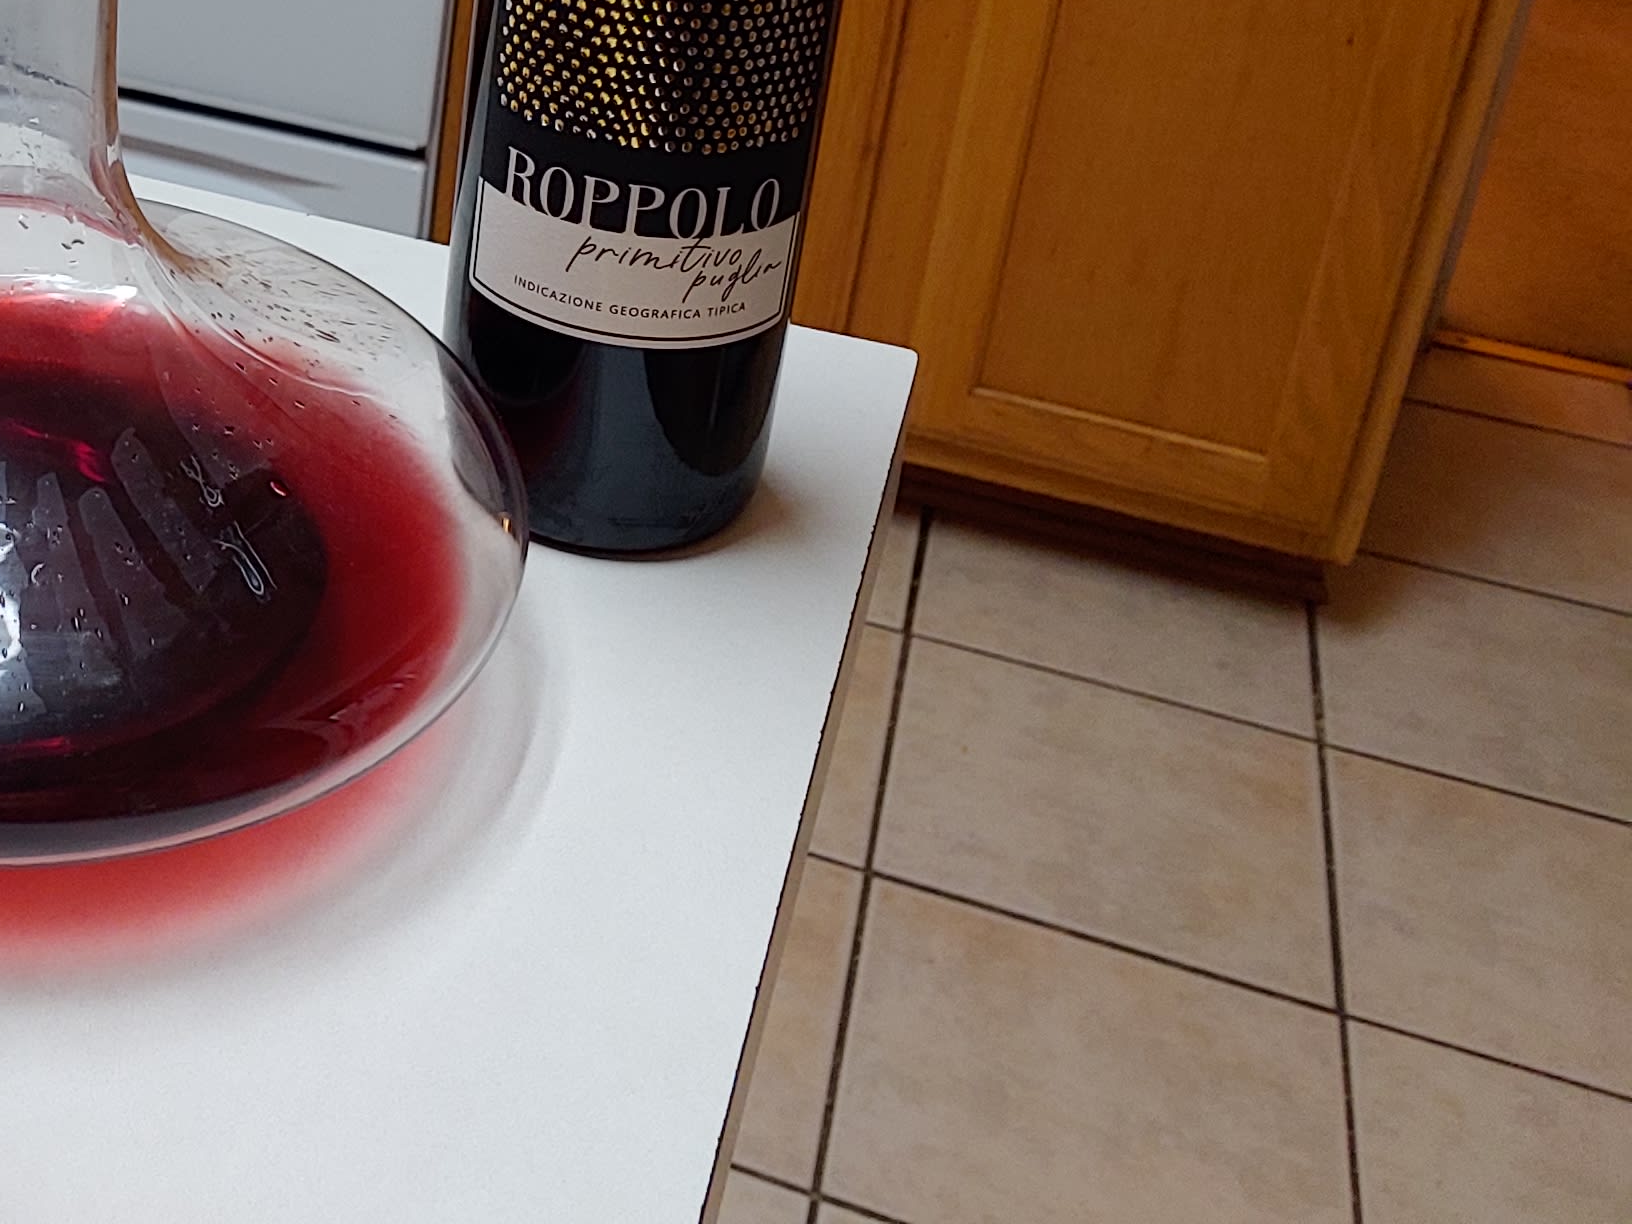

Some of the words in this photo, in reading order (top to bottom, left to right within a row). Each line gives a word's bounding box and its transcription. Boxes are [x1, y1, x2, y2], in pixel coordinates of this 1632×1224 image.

[504, 145, 780, 239] ROPPOLO
[565, 235, 742, 272] primitivo
[513, 274, 603, 313] INDICAZIONE
[608, 304, 701, 320] GEOGRAFICA
[707, 301, 746, 318] TIPICA
